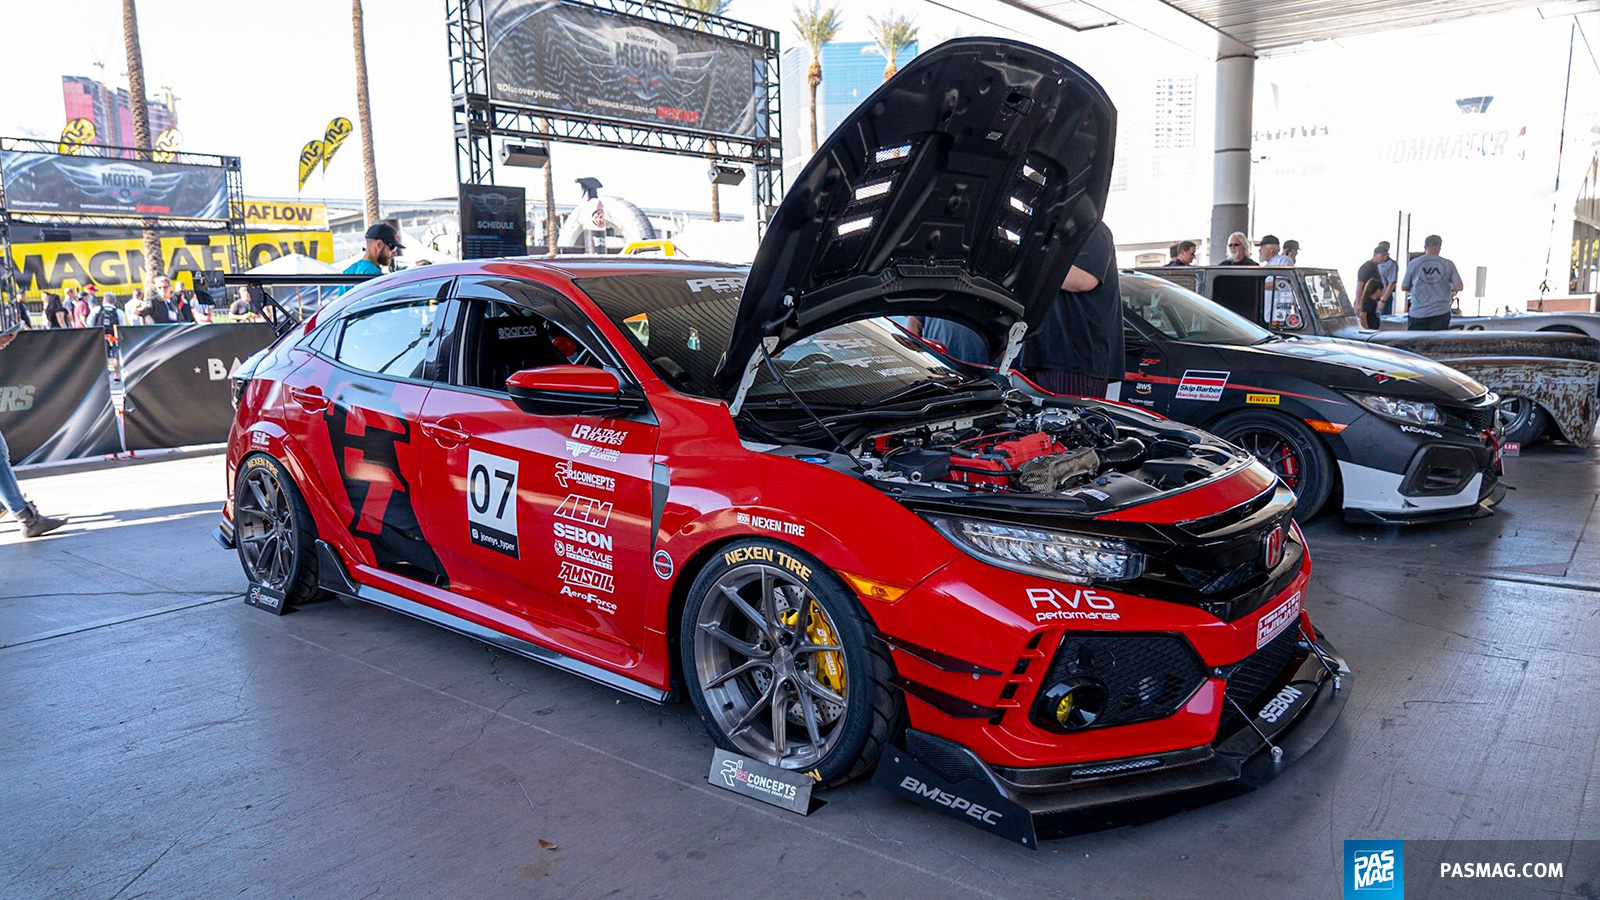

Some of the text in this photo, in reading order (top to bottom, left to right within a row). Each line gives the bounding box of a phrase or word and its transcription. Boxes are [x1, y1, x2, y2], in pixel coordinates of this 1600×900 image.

[625, 31, 659, 46] Discovery
[615, 40, 672, 72] MOTOR
[101, 172, 146, 188] MOTOR
[477, 220, 514, 230] SCHEDULE
[1136, 382, 1152, 390] aws
[1180, 384, 1222, 394] Skip Barber
[469, 464, 515, 520] 07
[553, 493, 613, 528] AEM
[553, 522, 613, 551] SEBON
[751, 514, 782, 532] NEXEN
[783, 521, 806, 537] TIRE
[565, 543, 613, 564] BLACKVUE
[724, 547, 813, 582] NEXEN TIRE
[558, 561, 615, 593] AMSOIL
[560, 585, 618, 610] AeroForce
[1026, 588, 1115, 609] RV6
[1036, 611, 1121, 622] performance
[1258, 684, 1303, 723] SEBON
[900, 775, 1003, 826] BMSPEC
